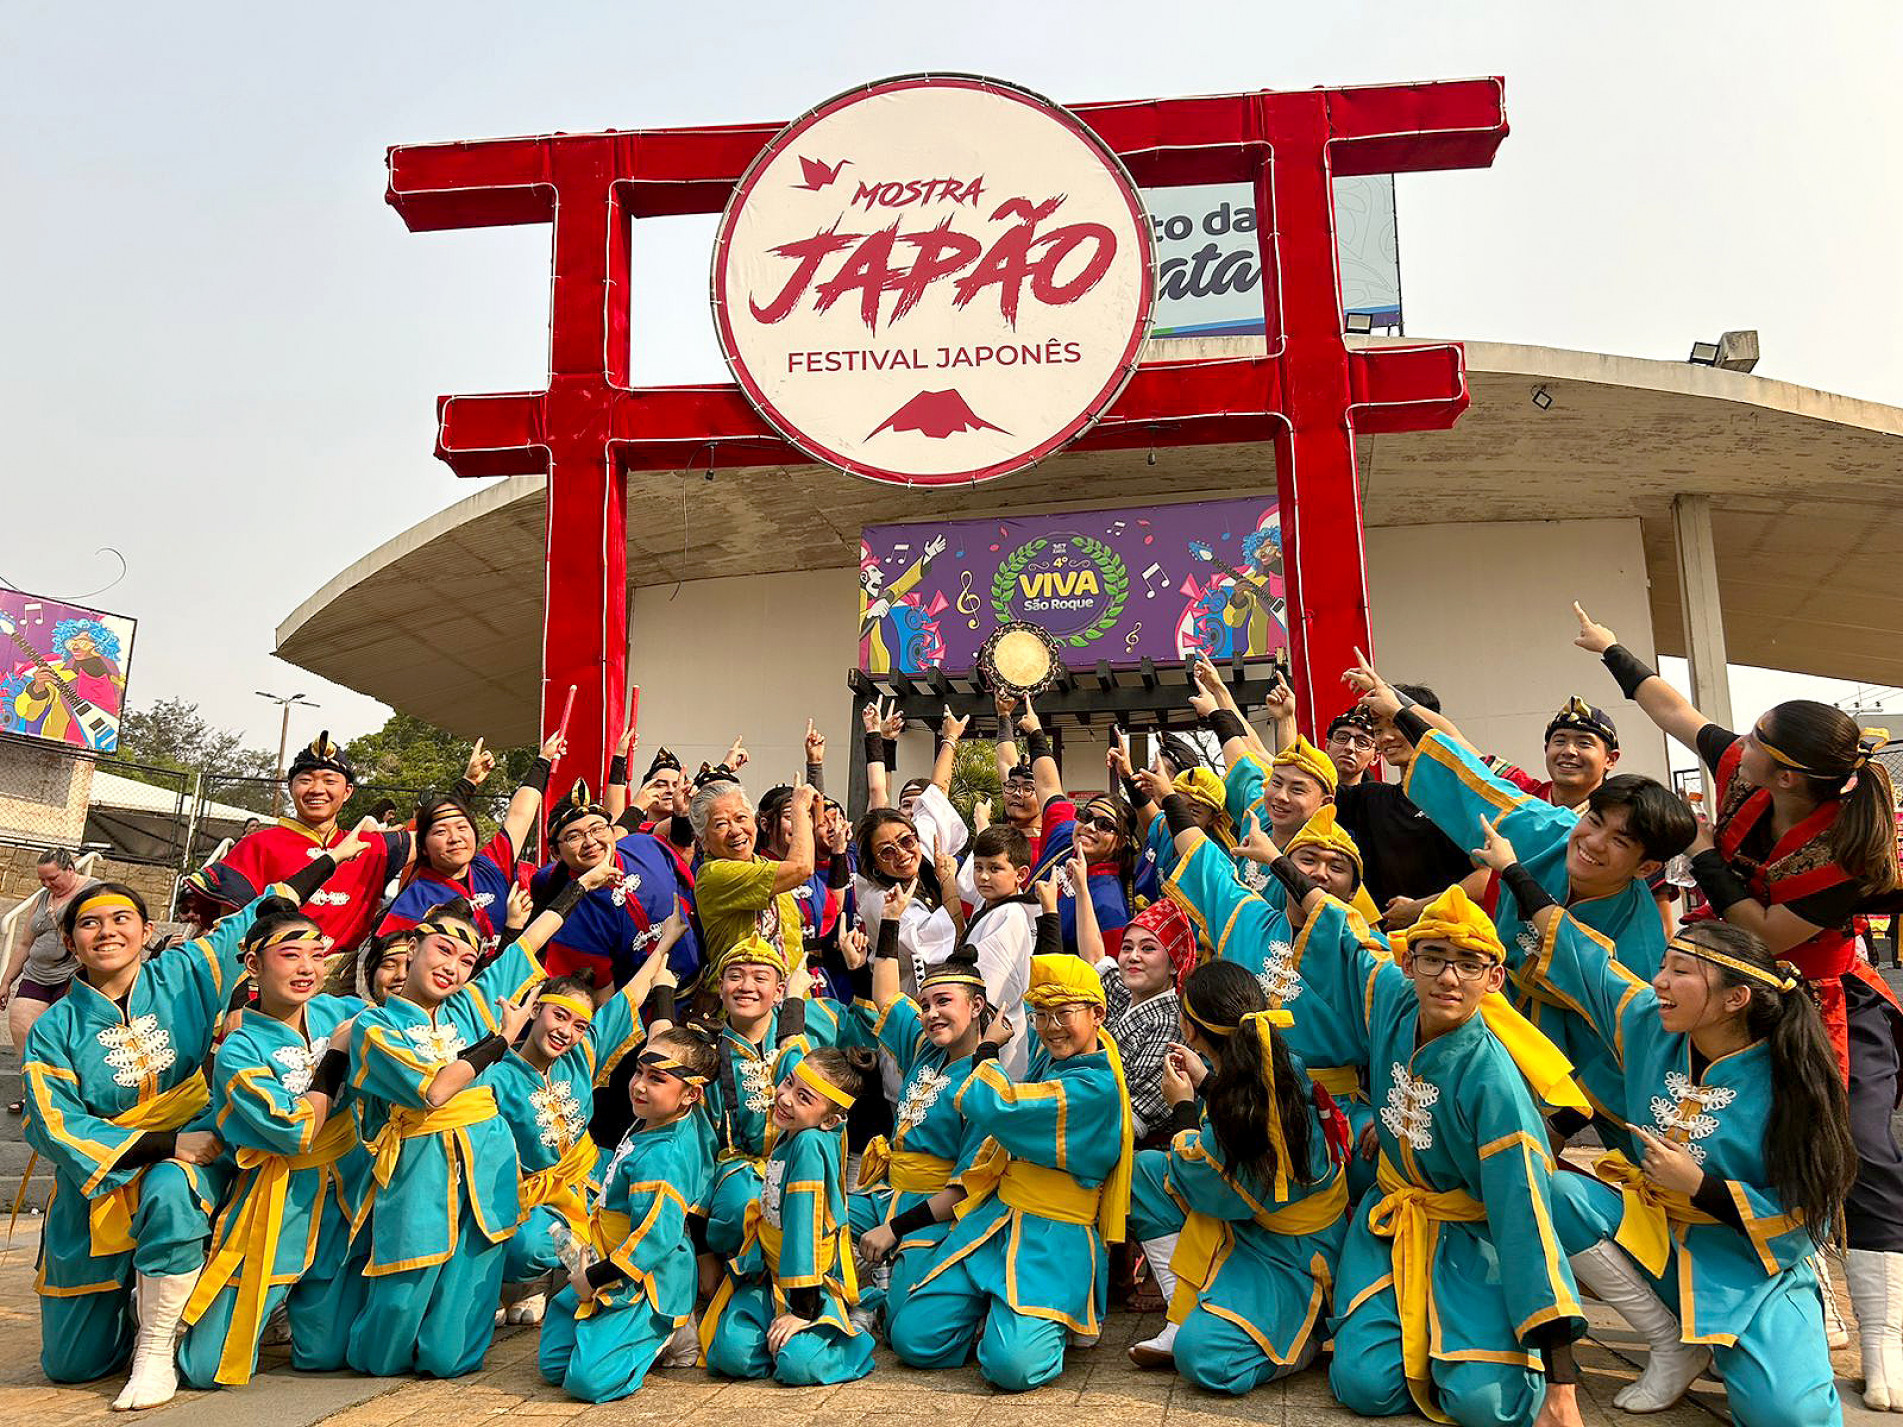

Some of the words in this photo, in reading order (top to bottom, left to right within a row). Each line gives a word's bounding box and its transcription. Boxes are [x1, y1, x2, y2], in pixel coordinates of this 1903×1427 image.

[851, 173, 988, 212] MOSTRA
[749, 192, 1117, 338] JAPÃO
[787, 349, 928, 373] FESTIVAL
[936, 337, 1082, 369] JAPONÊS
[1019, 570, 1099, 598] VIVA
[1023, 599, 1049, 611] São
[1051, 598, 1094, 610] Roque
